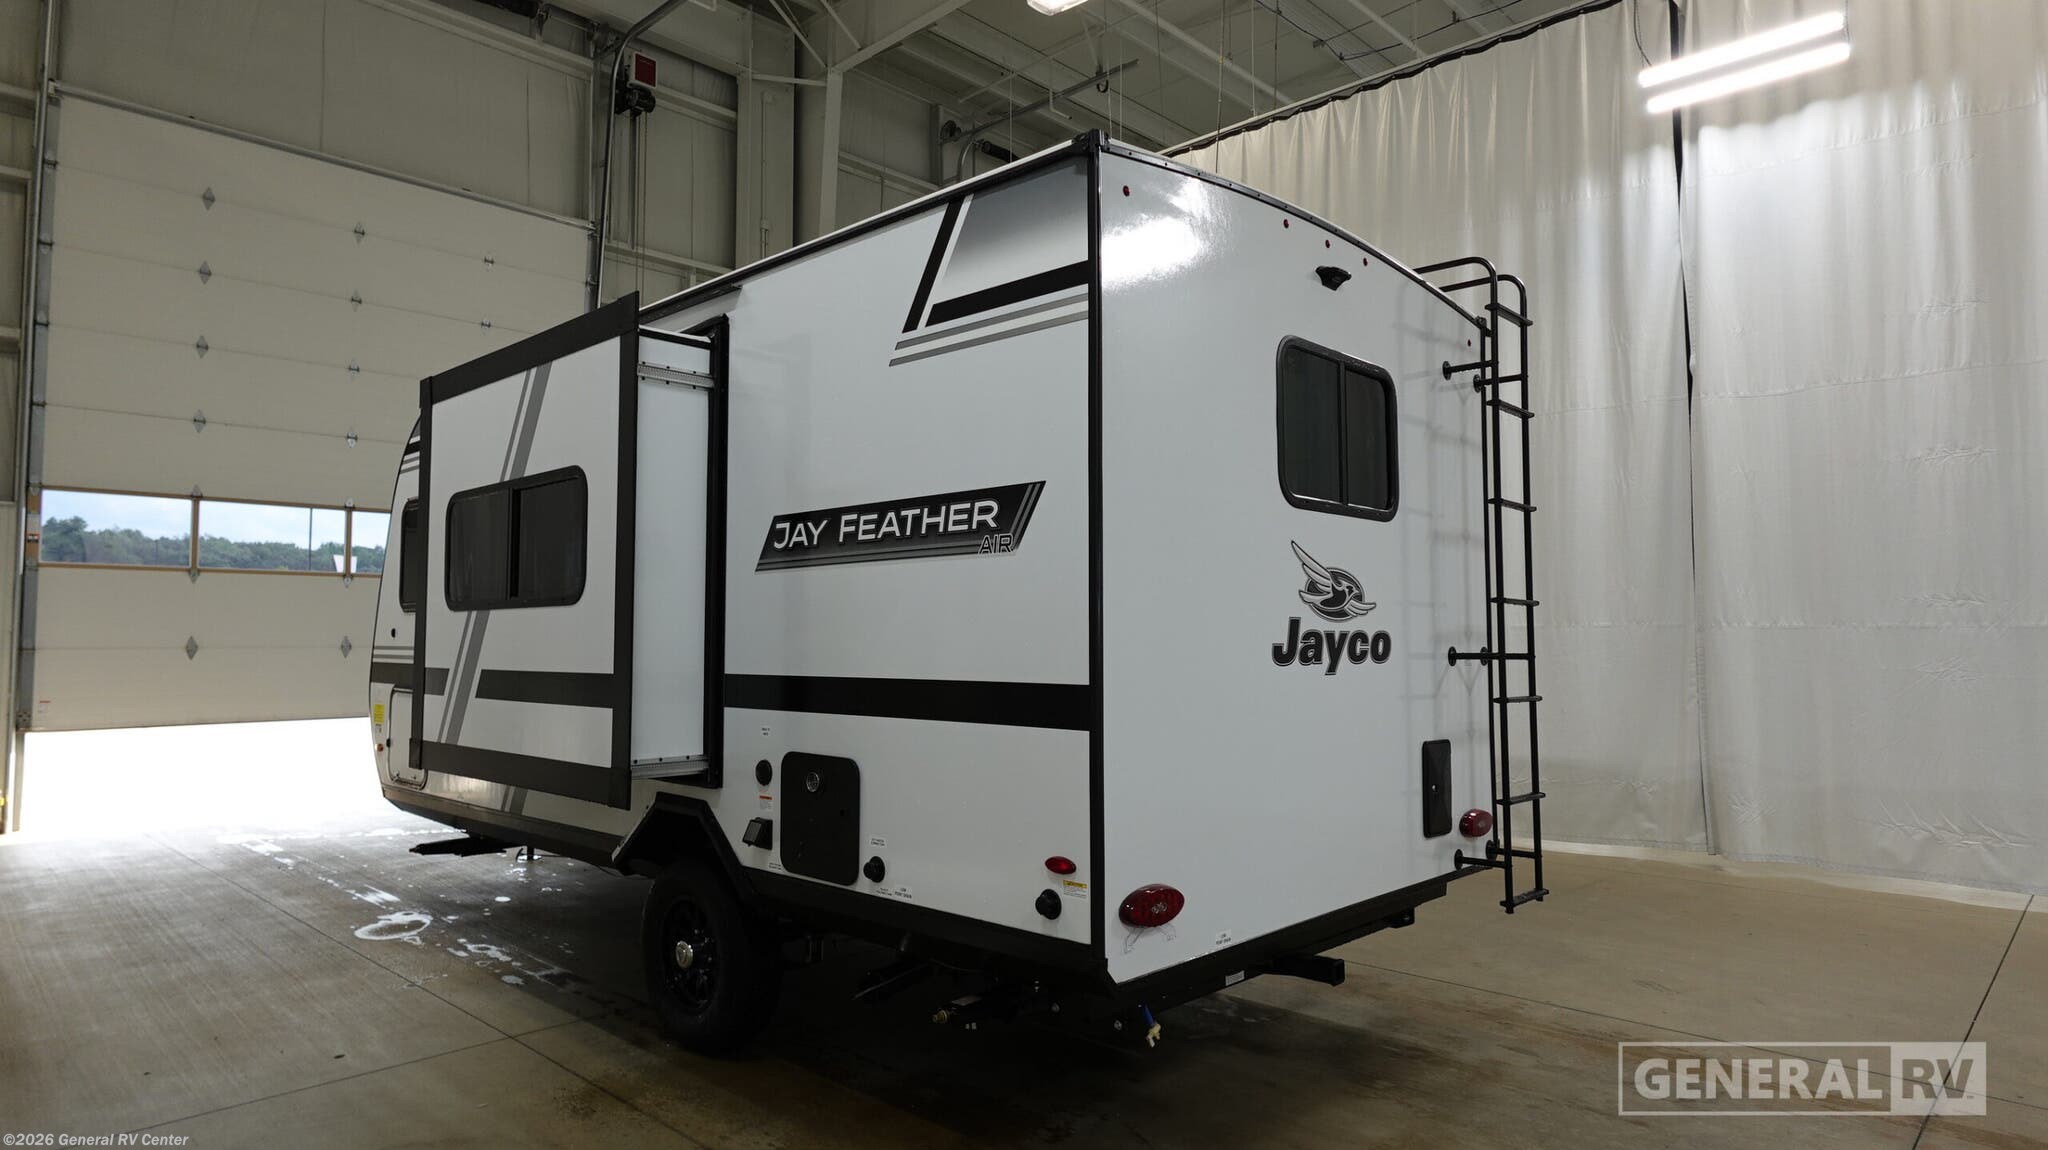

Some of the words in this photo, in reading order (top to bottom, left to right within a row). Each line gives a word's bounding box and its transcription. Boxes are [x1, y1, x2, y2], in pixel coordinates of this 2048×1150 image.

[774, 519, 828, 549] JAY
[838, 500, 1000, 543] FEATHER
[978, 533, 1014, 556] AIR
[1271, 616, 1392, 676] Jayco
